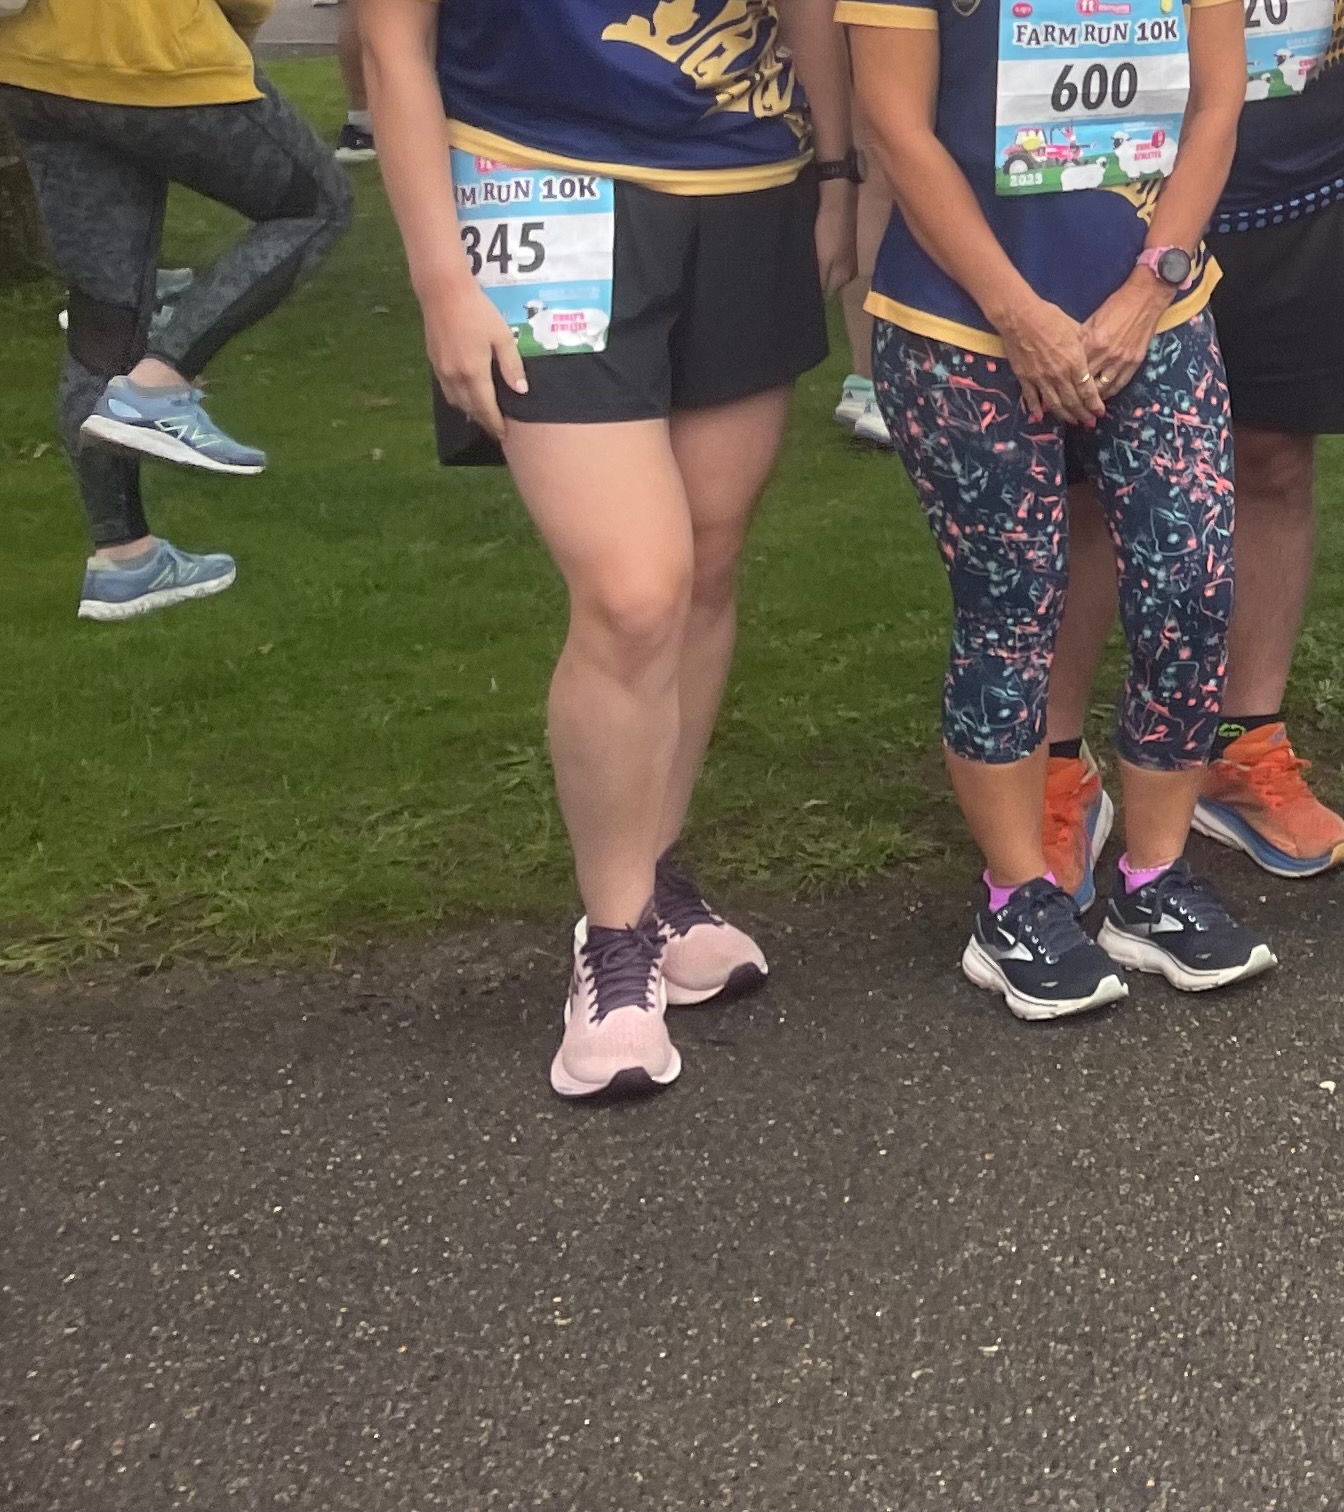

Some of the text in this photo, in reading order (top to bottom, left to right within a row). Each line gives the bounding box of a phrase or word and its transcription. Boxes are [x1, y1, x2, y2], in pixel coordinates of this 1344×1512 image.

[1016, 19, 1177, 46] FARM RUN 10K
[1051, 62, 1138, 112] 600
[483, 180, 530, 203] RUN
[542, 176, 597, 199] 10K
[460, 221, 545, 276] 345
